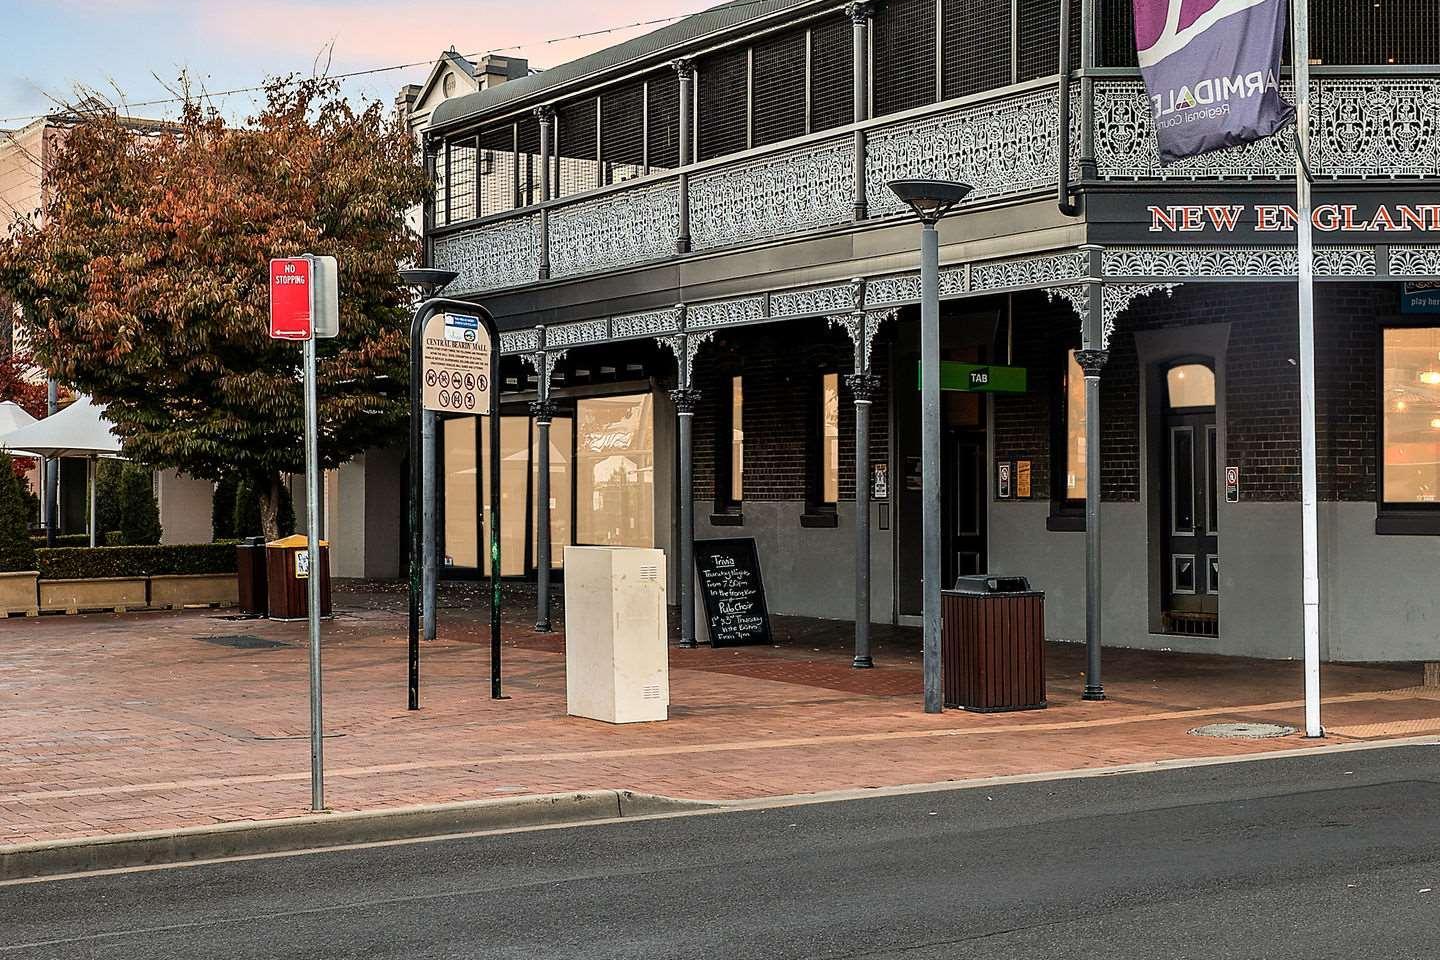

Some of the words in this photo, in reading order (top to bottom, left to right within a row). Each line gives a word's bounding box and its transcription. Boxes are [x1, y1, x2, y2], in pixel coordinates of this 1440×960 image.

[1147, 205, 1244, 232] NEW
[284, 264, 296, 273] NO
[275, 275, 305, 284] STOPPING
[1411, 297, 1427, 307] play
[426, 338, 451, 347] CENTRAL
[472, 343, 488, 352] MALL
[970, 373, 988, 383] TAB
[710, 554, 735, 565] Trivia
[718, 602, 734, 613] Pub
[734, 601, 753, 611] Choir
